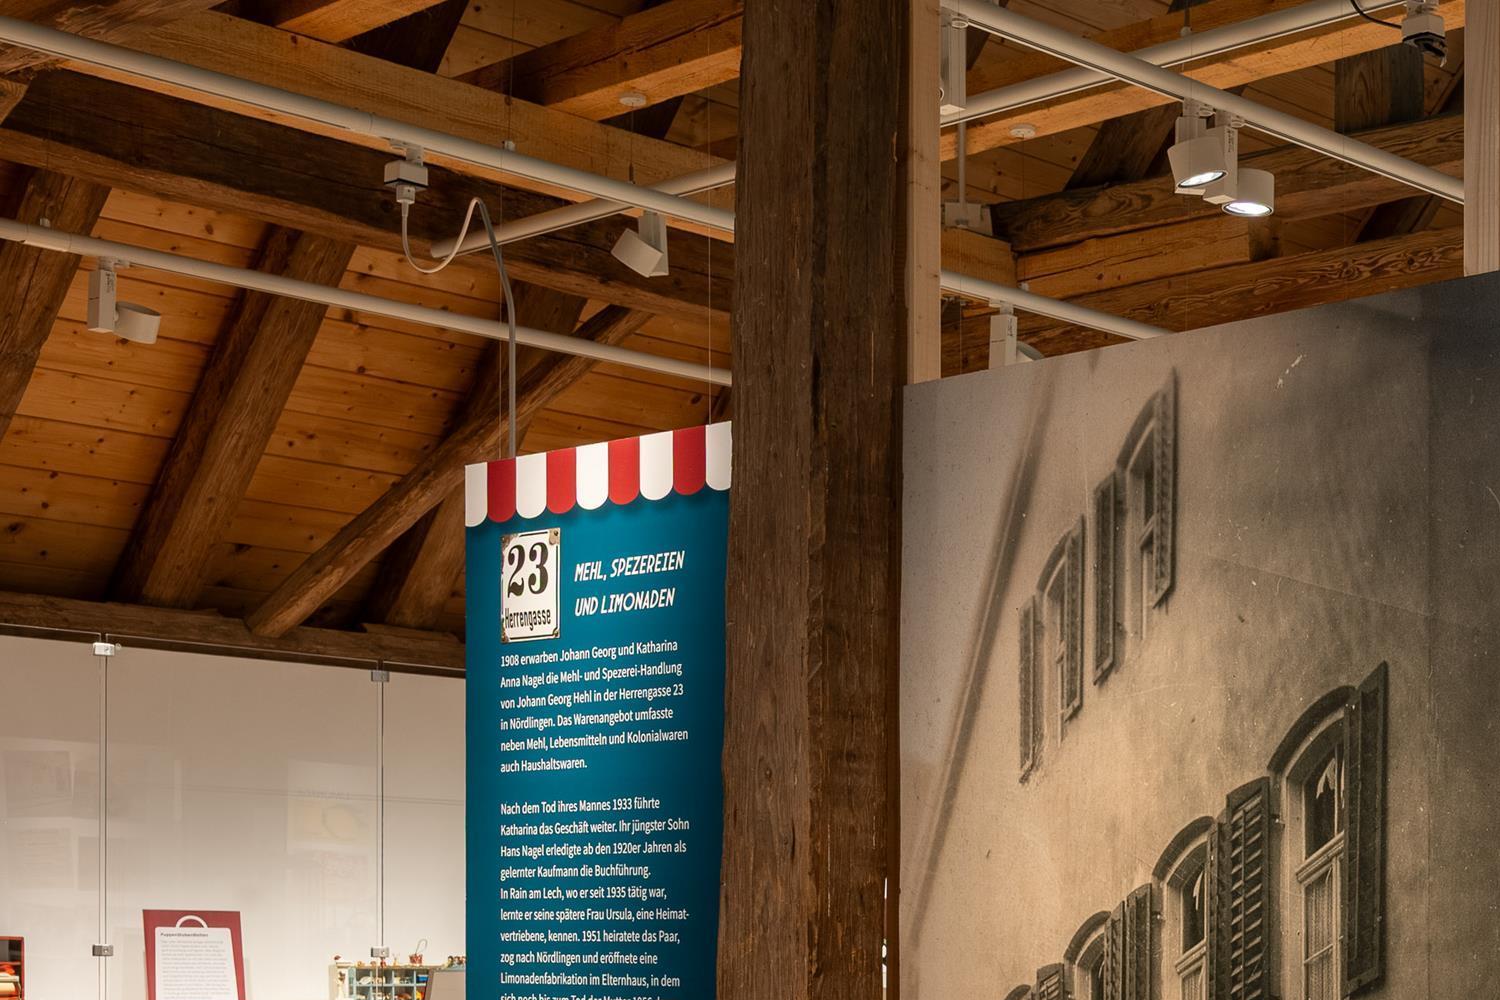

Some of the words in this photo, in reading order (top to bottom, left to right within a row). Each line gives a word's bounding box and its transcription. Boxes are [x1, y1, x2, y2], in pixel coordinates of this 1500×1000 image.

[508, 542, 549, 598] 23
[574, 561, 607, 581] MEHL,
[610, 551, 685, 577] SPEZEREIEN
[575, 597, 599, 616] UND
[600, 588, 676, 613] LIMONADEN
[504, 608, 552, 631] Herrengasse
[501, 655, 520, 667] 1908
[520, 652, 558, 665] erwarben
[560, 649, 590, 661] Johann
[592, 647, 617, 660] Georg
[618, 642, 635, 656] und
[636, 640, 678, 654] Katharina
[500, 677, 521, 688] Anna
[522, 673, 545, 688] Nagel
[546, 672, 559, 684] die
[560, 670, 583, 682] Mehl-
[584, 668, 601, 681] und
[602, 662, 683, 681] Spezerei-Handlung
[500, 700, 515, 709] von
[516, 696, 547, 708] Johann
[547, 694, 572, 707] Georg
[573, 690, 592, 703] Hehl
[594, 690, 602, 702] in
[603, 689, 618, 701] der
[619, 687, 672, 701] Herrengasse
[673, 684, 684, 695] 23
[501, 719, 508, 730] in
[510, 717, 556, 731] Nördlingen.
[557, 715, 573, 726] Das
[573, 710, 634, 726] Warenangebot
[635, 707, 673, 720] umfasste
[501, 739, 525, 751] neben
[526, 737, 548, 750] Mehl,
[550, 734, 608, 748] Lebensmitteln
[609, 732, 625, 744] und
[627, 730, 688, 743] Kolonialwaren
[501, 760, 520, 772] auch
[521, 758, 587, 771] Haushaltswaren.
[501, 803, 521, 814] Nach
[522, 802, 540, 814] dem
[541, 801, 556, 813] Tod
[558, 801, 578, 812] ihres
[579, 800, 611, 811] Mannes
[612, 798, 632, 810] 1933
[634, 797, 660, 809] führte
[501, 824, 538, 836] Katharina
[539, 823, 554, 835] das
[554, 821, 589, 834] Geschäft
[590, 821, 618, 832] weiter.
[619, 820, 631, 832] Ihr
[632, 820, 666, 834] jüngster
[668, 818, 690, 830] Sohn
[500, 866, 536, 881] gelernter
[537, 865, 579, 877] Kaufmann
[580, 865, 593, 876] die
[595, 864, 651, 878] Buchführung.
[501, 909, 524, 920] lernte
[524, 912, 533, 920] er
[534, 909, 555, 920] seine
[555, 909, 586, 923] spätere
[586, 909, 605, 920] Frau
[606, 908, 635, 922] Ursula,
[636, 908, 654, 920] eine
[656, 908, 689, 919] Heimat-
[500, 930, 547, 943] vertriebene,
[548, 930, 580, 942] kennen.
[582, 931, 601, 942] 1951
[603, 930, 640, 942] heiratete
[642, 930, 657, 942] das
[659, 930, 680, 944] Paar,
[500, 954, 515, 966] zog
[516, 951, 535, 963] nach
[536, 951, 581, 966] Nördlingen
[582, 952, 599, 963] und
[600, 952, 638, 964] eröffnete
[639, 952, 658, 964] eine
[500, 972, 588, 985] Limonadenfabrikation
[590, 974, 600, 985] im
[602, 974, 649, 988] Elternhaus,
[651, 975, 659, 986] in
[661, 975, 680, 986] dem
